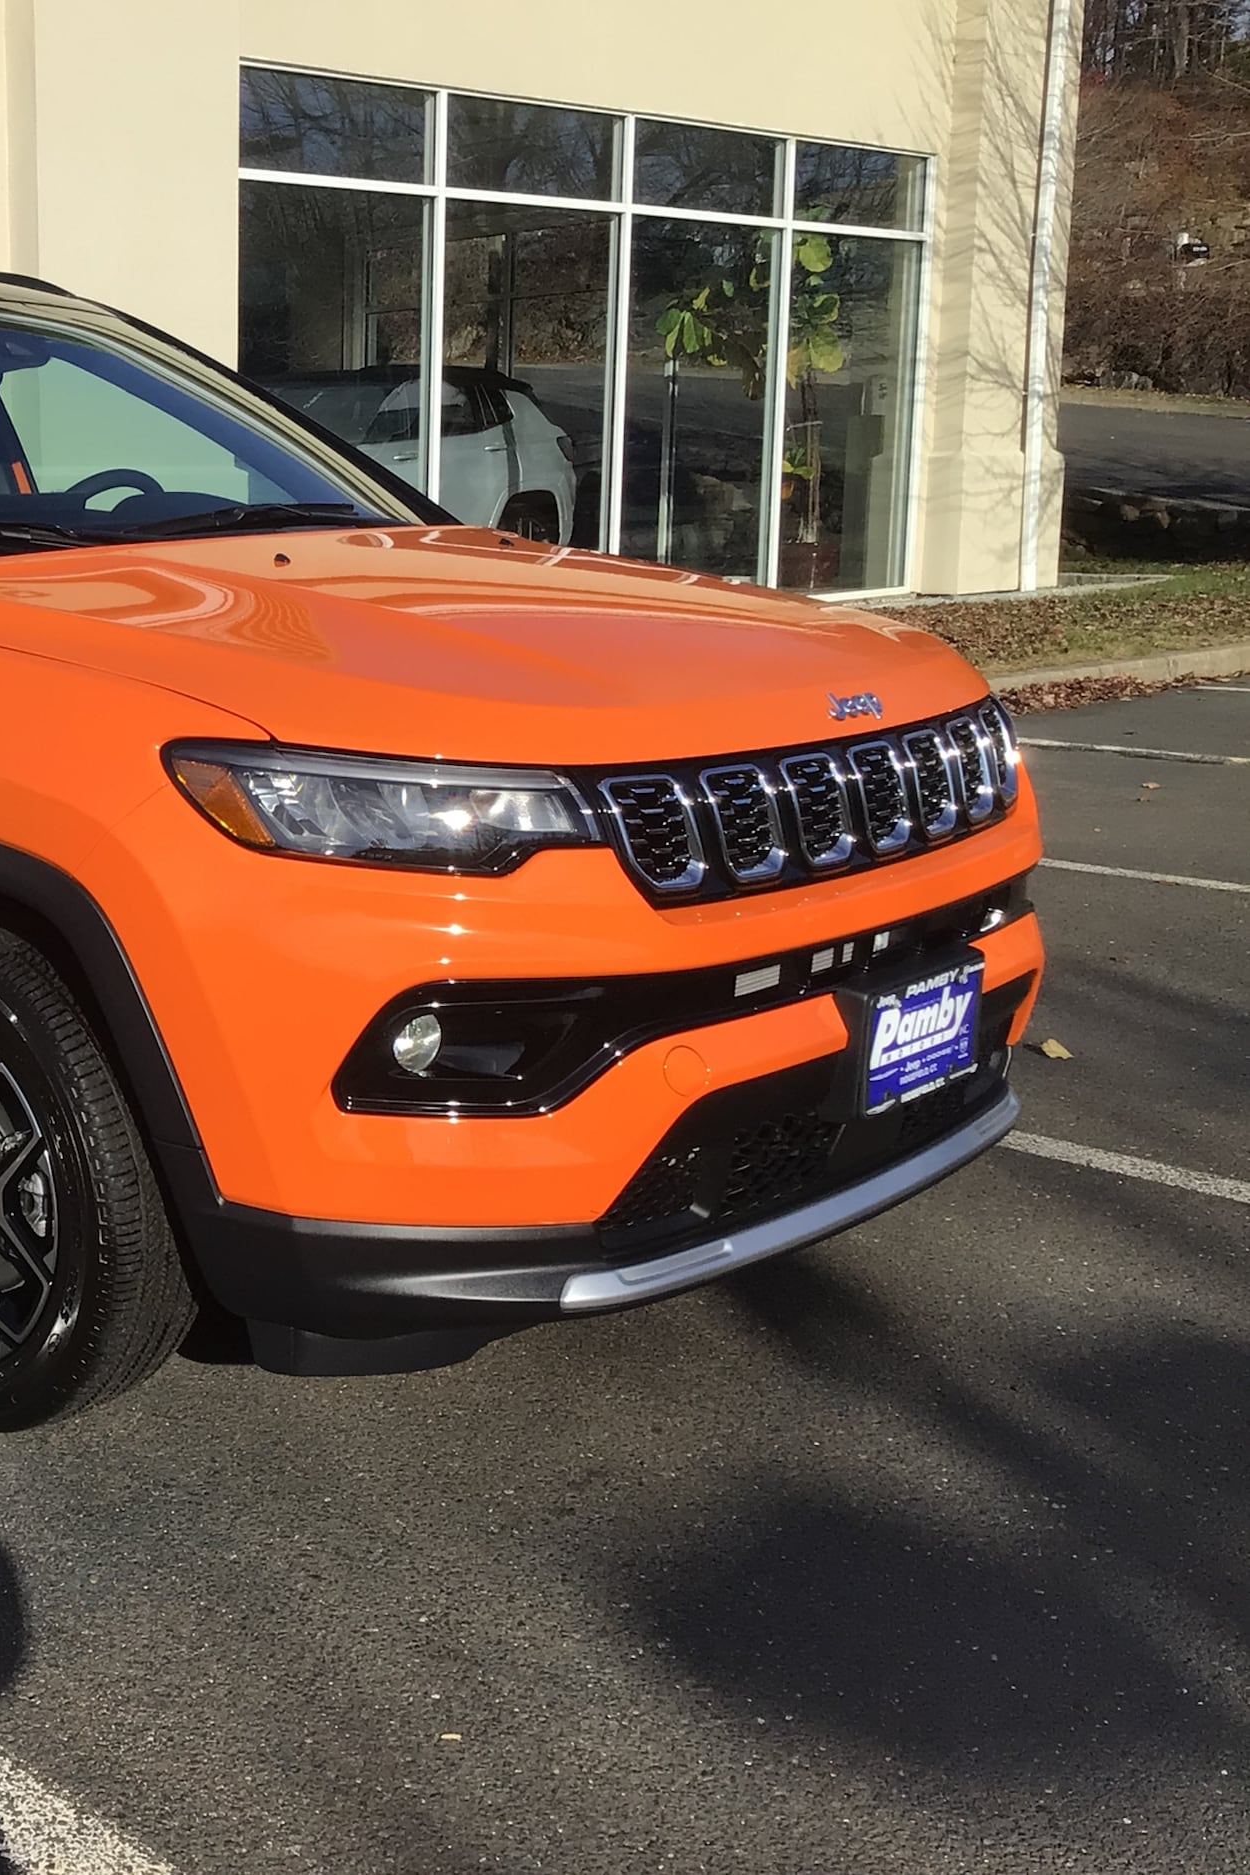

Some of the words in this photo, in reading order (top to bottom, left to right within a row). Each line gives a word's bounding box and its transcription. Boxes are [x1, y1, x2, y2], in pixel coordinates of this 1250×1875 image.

[826, 692, 882, 720] Jeep
[905, 968, 959, 999] PAMBY
[869, 986, 973, 1070] Pamby
